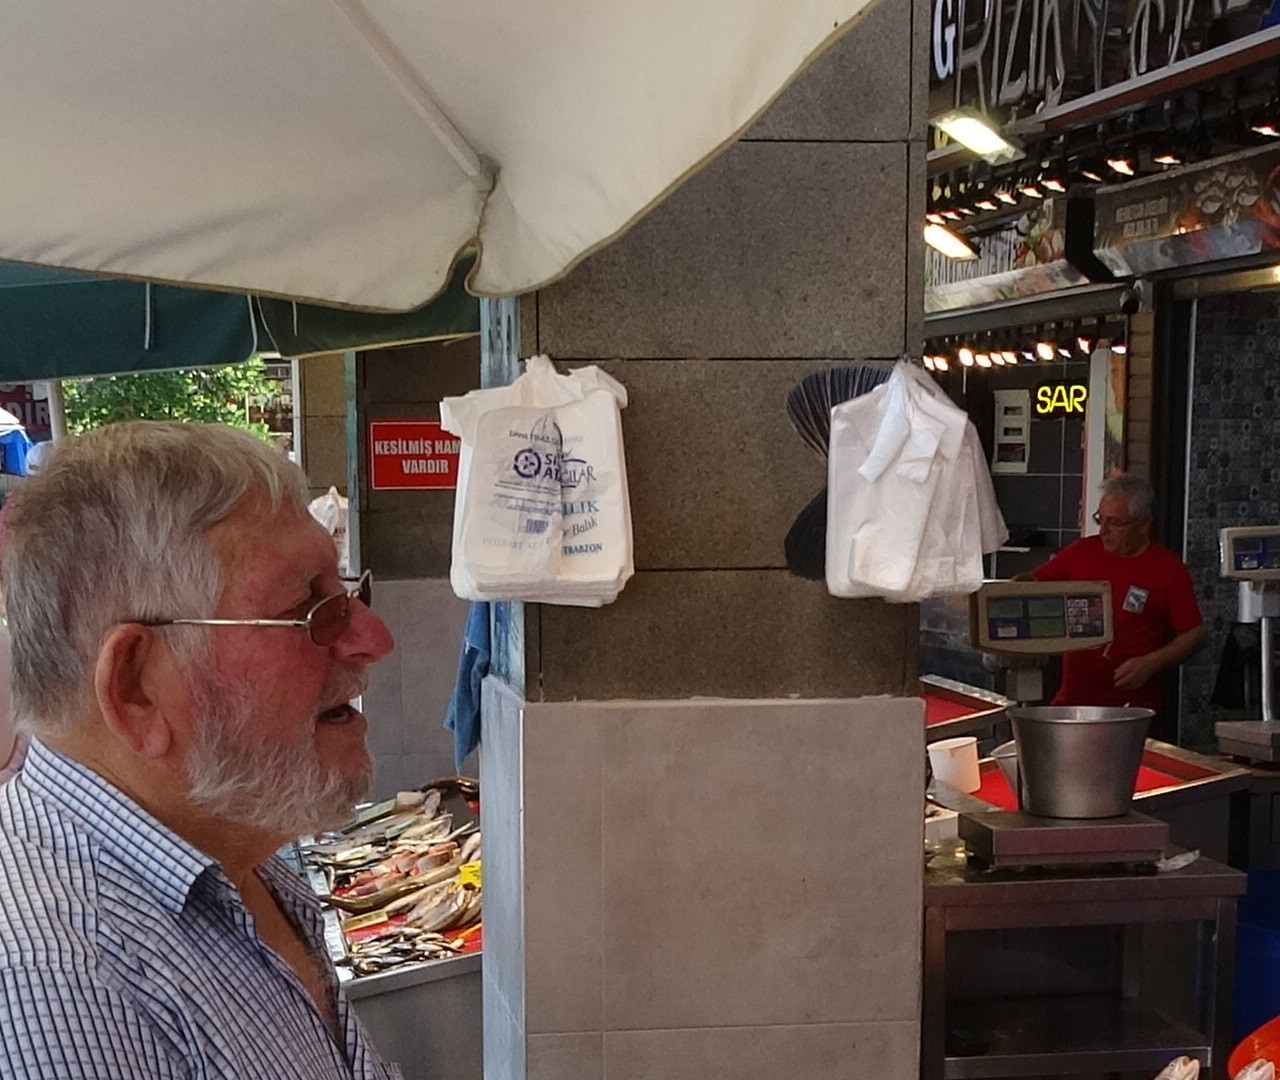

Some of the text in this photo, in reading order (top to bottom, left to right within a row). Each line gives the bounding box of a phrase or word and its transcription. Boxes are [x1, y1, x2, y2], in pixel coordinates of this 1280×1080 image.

[375, 438, 433, 457] KESİLMİŞ
[402, 459, 449, 474] VARDIR
[563, 543, 603, 556] TRABZON
